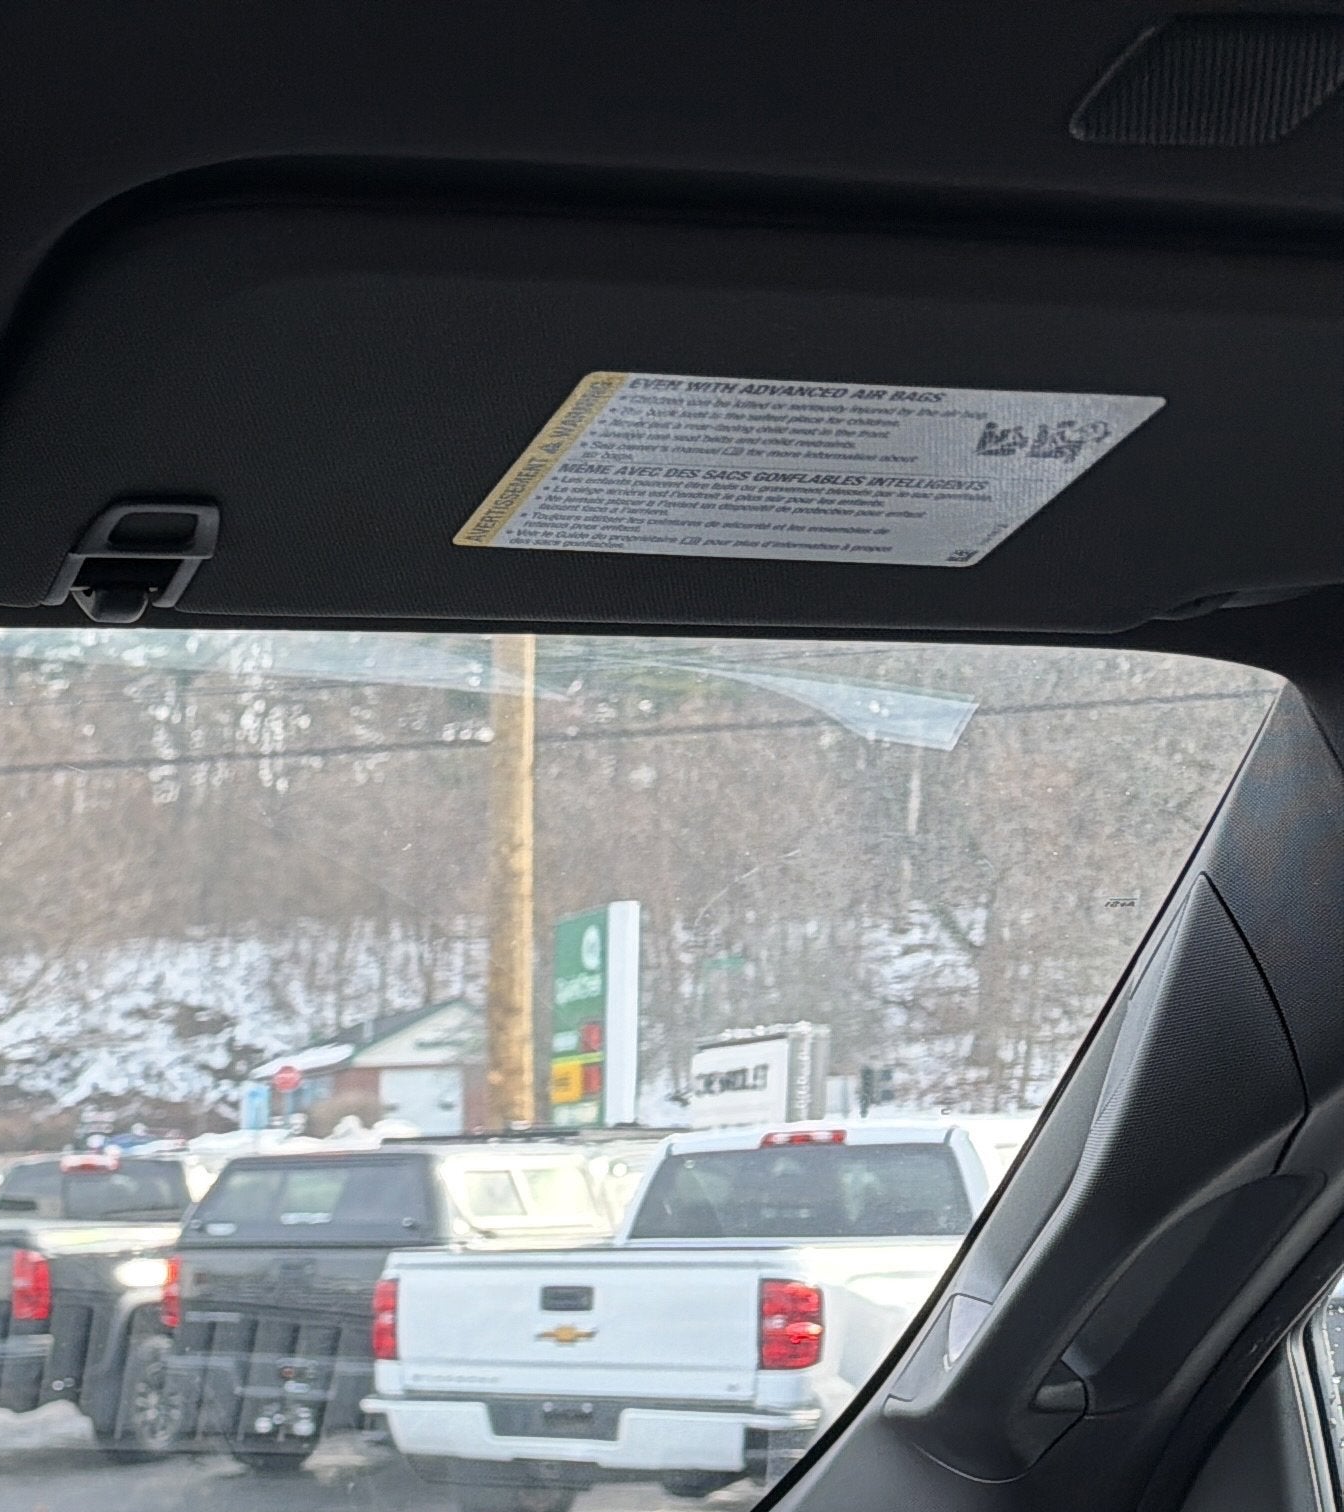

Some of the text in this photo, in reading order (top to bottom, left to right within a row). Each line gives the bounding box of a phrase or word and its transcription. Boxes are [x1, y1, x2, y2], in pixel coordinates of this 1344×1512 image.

[629, 378, 947, 403] EVEN WITH ADVANCED AIR BAGS
[559, 462, 612, 476] MÊME
[613, 465, 663, 478] AVEC
[664, 468, 699, 479] DES
[701, 469, 751, 481] SACS
[864, 476, 989, 491] INTELLIGENTS
